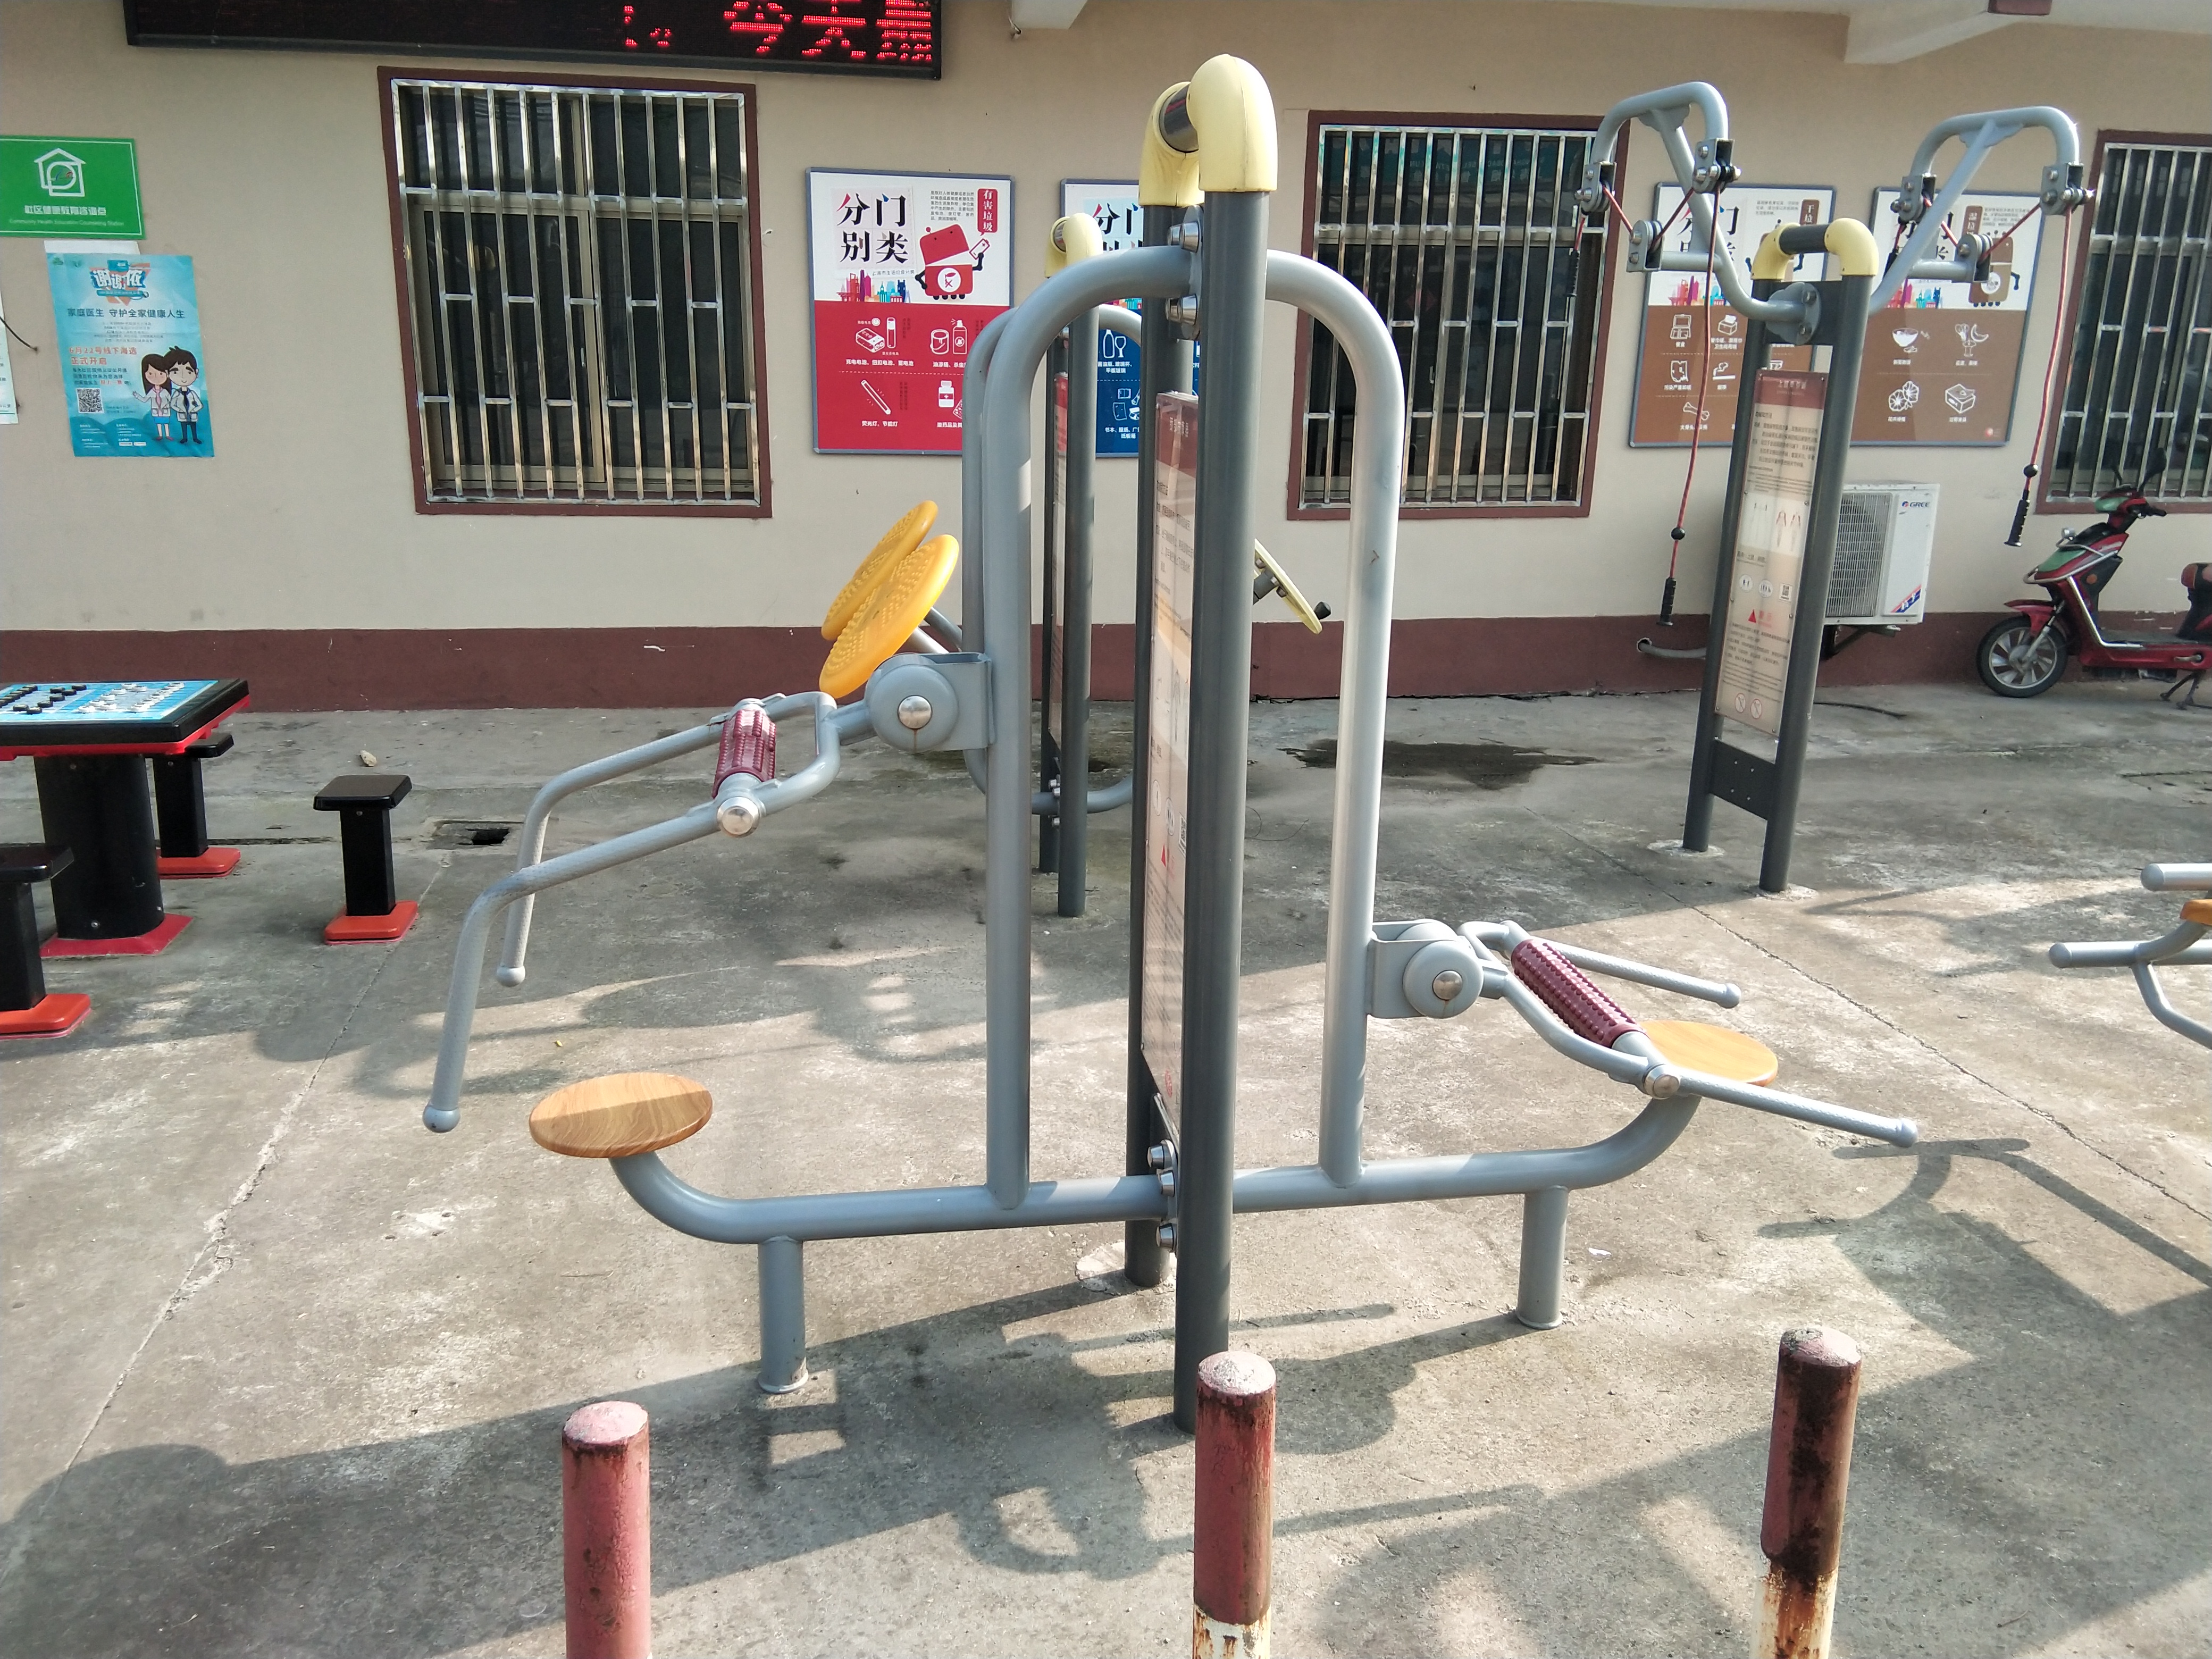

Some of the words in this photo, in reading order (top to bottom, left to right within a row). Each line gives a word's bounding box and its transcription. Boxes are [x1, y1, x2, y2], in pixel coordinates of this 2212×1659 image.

[836, 192, 906, 227] 分门
[983, 189, 993, 231] 有害垃圾
[840, 230, 908, 264] 别类
[68, 308, 104, 317] 家庭医生
[109, 308, 185, 318] 守护全家健康人生
